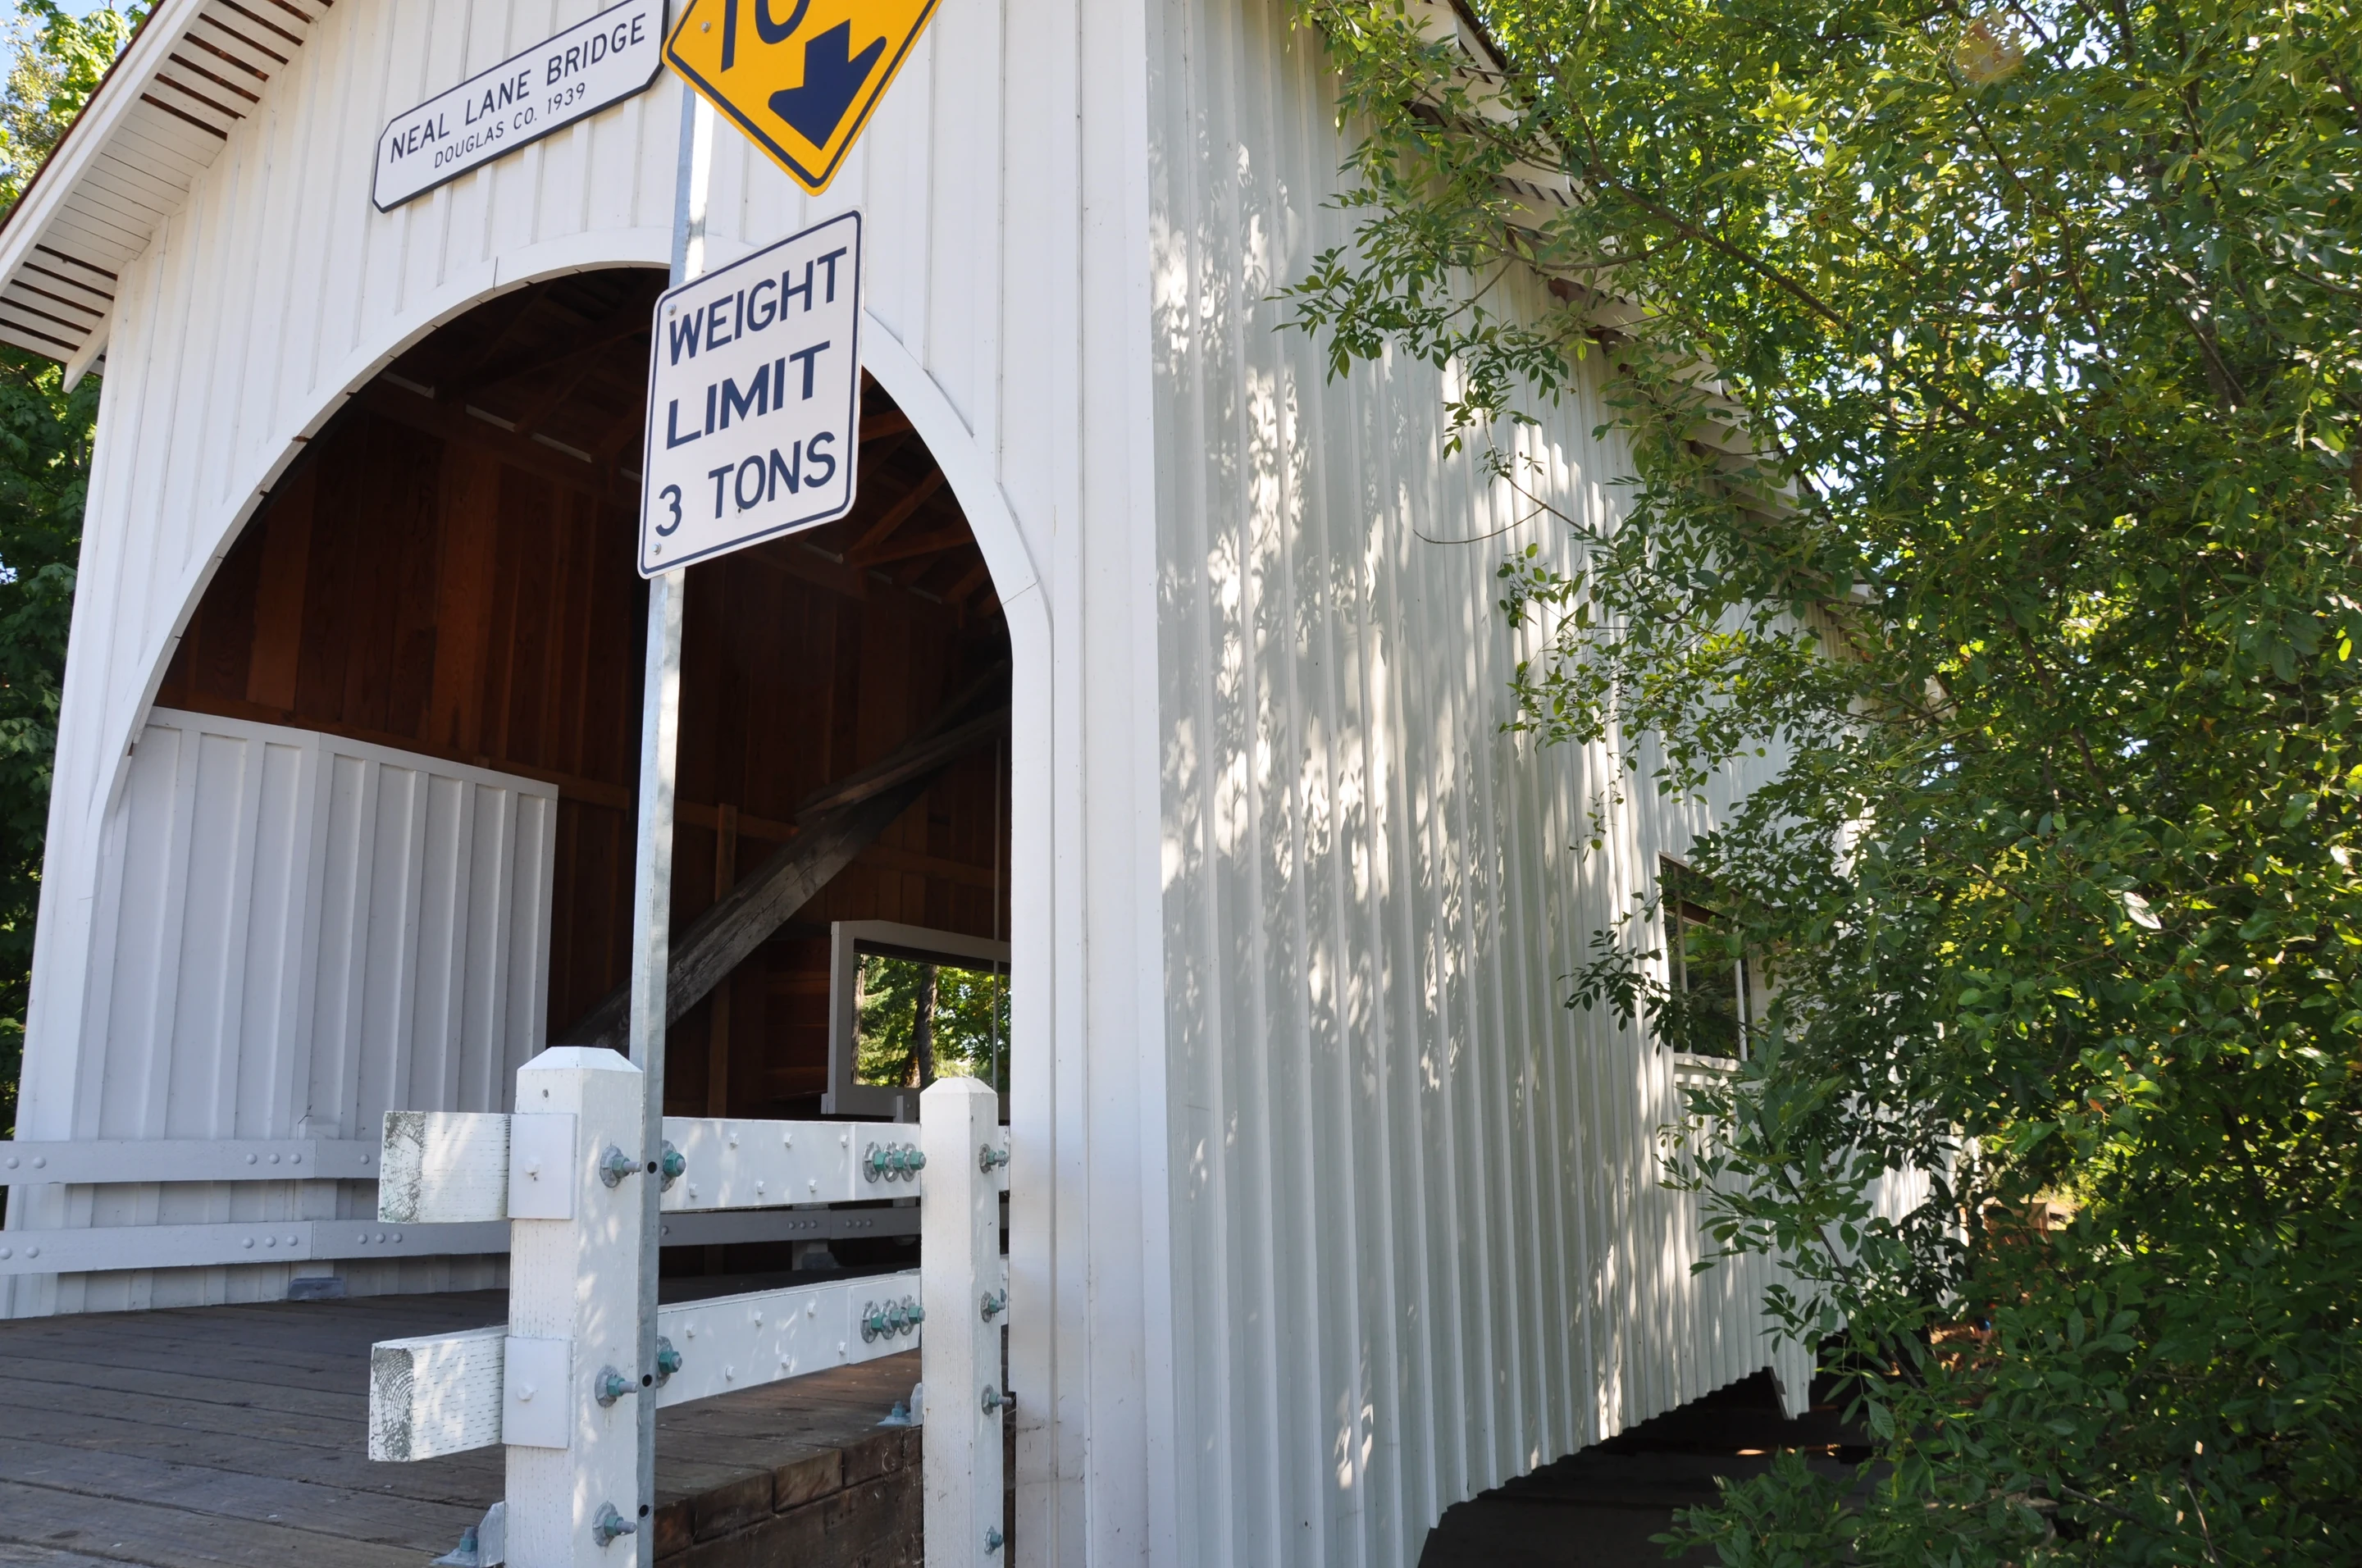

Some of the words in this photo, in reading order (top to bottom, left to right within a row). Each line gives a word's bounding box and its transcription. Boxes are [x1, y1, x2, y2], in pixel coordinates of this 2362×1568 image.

[390, 113, 450, 163] NEAL
[465, 69, 531, 126] LANE
[546, 12, 646, 86] BRIDGE
[435, 121, 504, 169] DOUGLAS
[513, 107, 537, 130] CO.
[548, 82, 586, 114] 1939
[669, 246, 847, 367] WEIGHT
[666, 340, 831, 450] LIMIT
[655, 484, 682, 537] 3
[708, 431, 837, 519] TONS
